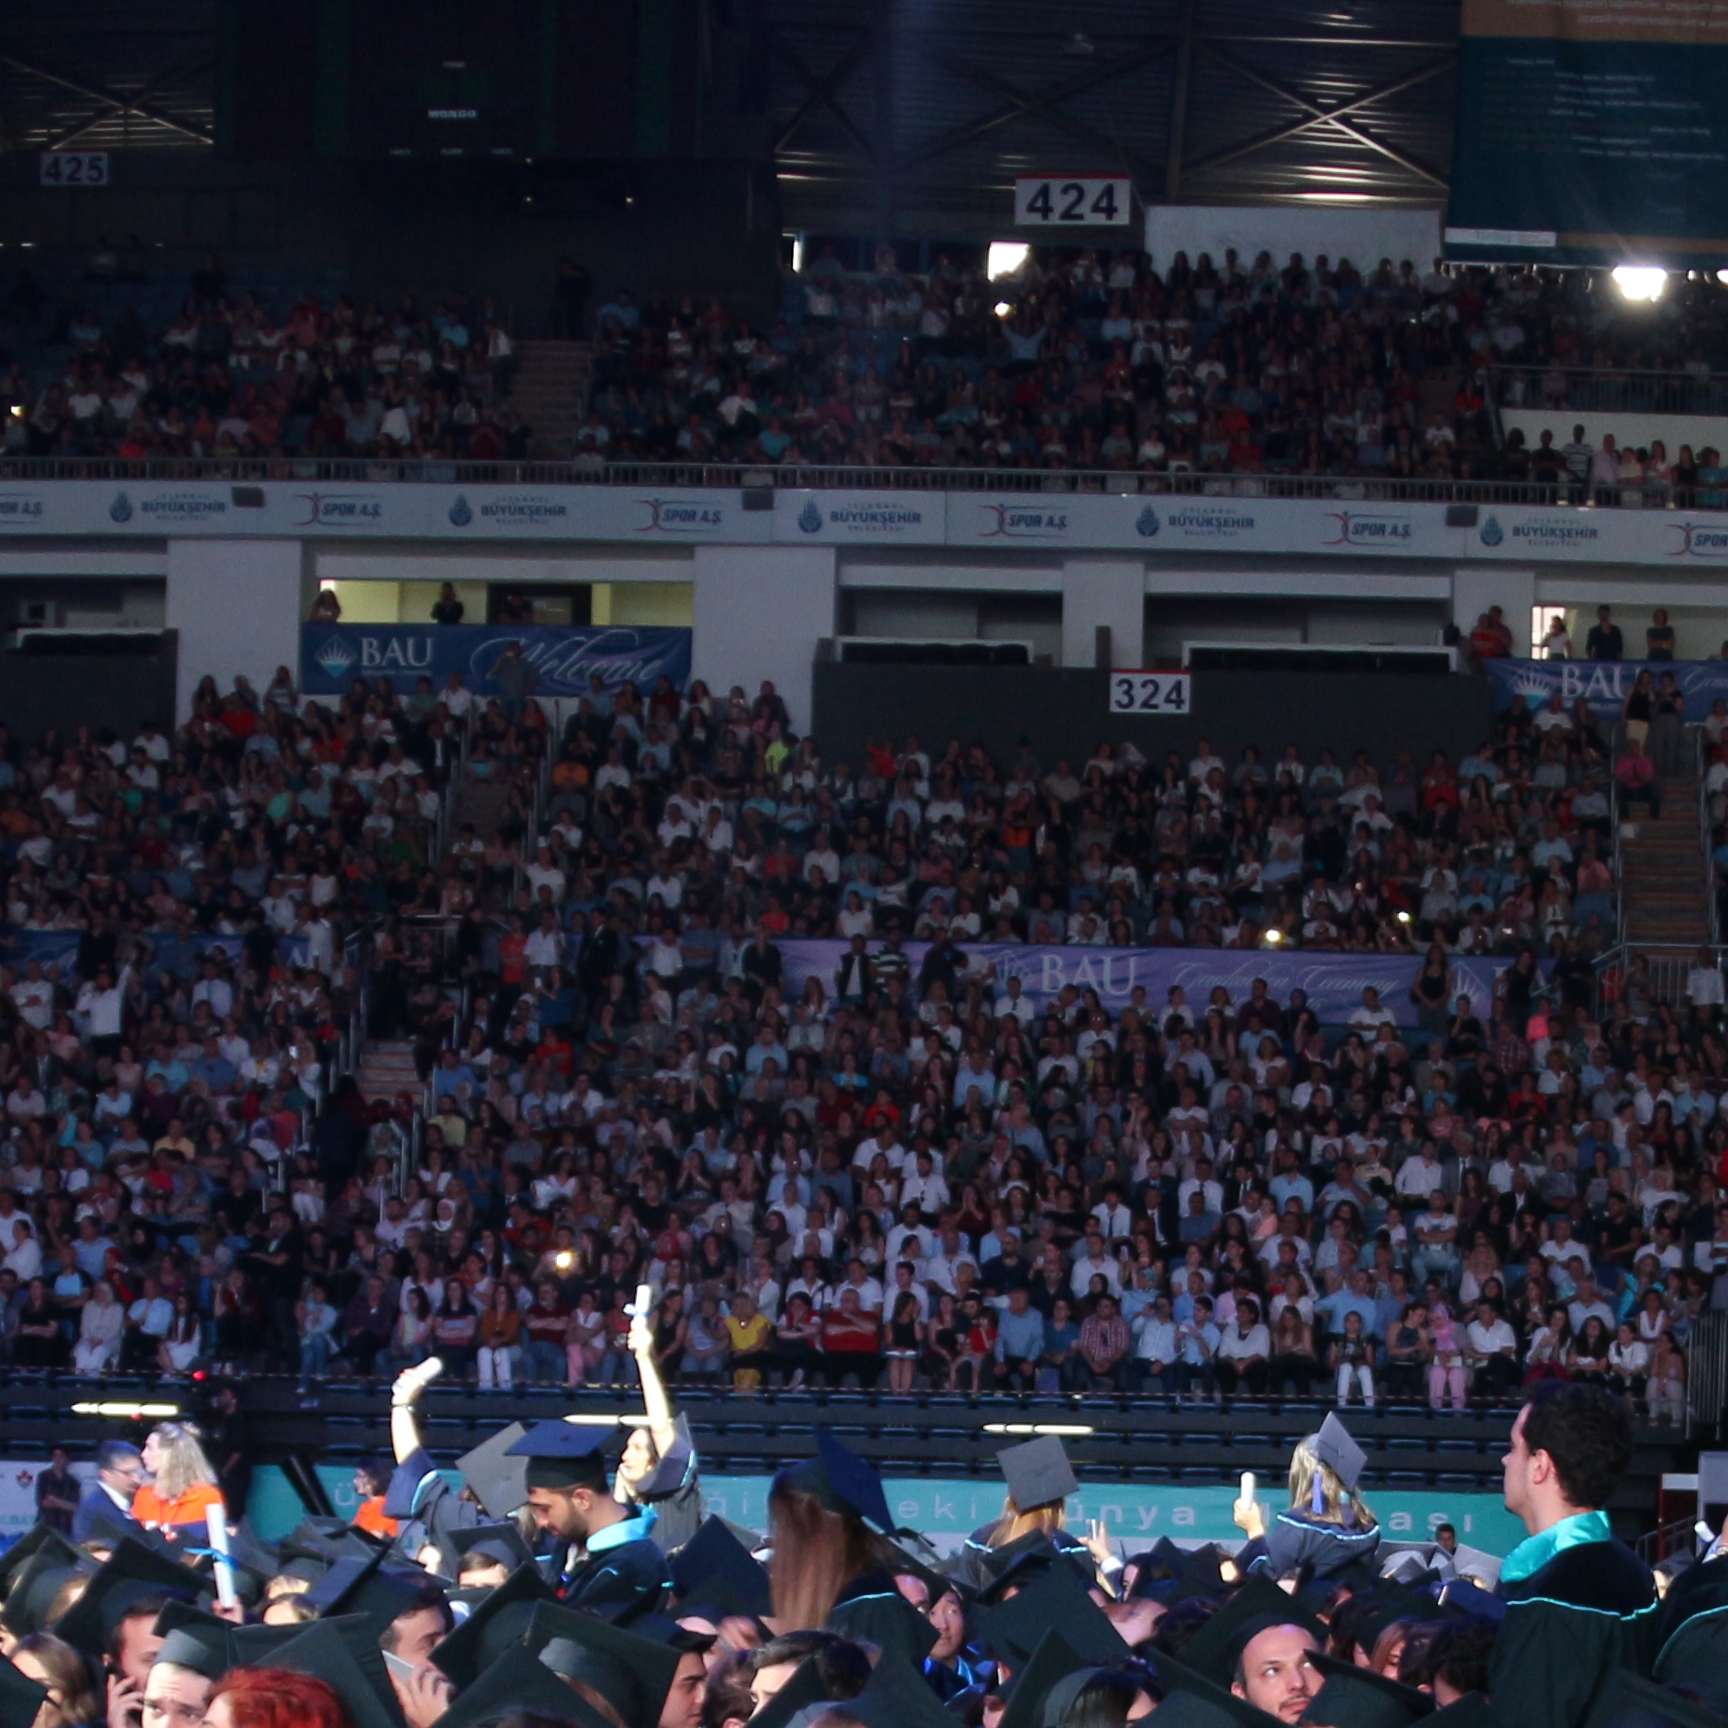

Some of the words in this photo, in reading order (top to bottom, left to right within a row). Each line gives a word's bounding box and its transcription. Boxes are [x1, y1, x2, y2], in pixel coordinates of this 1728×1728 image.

[43, 156, 104, 183] 425
[1026, 182, 1118, 221] 424
[322, 503, 356, 515] SPOR
[663, 509, 697, 522] SPOR
[1009, 514, 1041, 527] SPOR
[1352, 523, 1385, 536] SPOR
[1694, 533, 1727, 546] SPOR
[360, 637, 434, 667] BAU
[1114, 679, 1185, 710] 324
[1040, 954, 1139, 995] BAU
